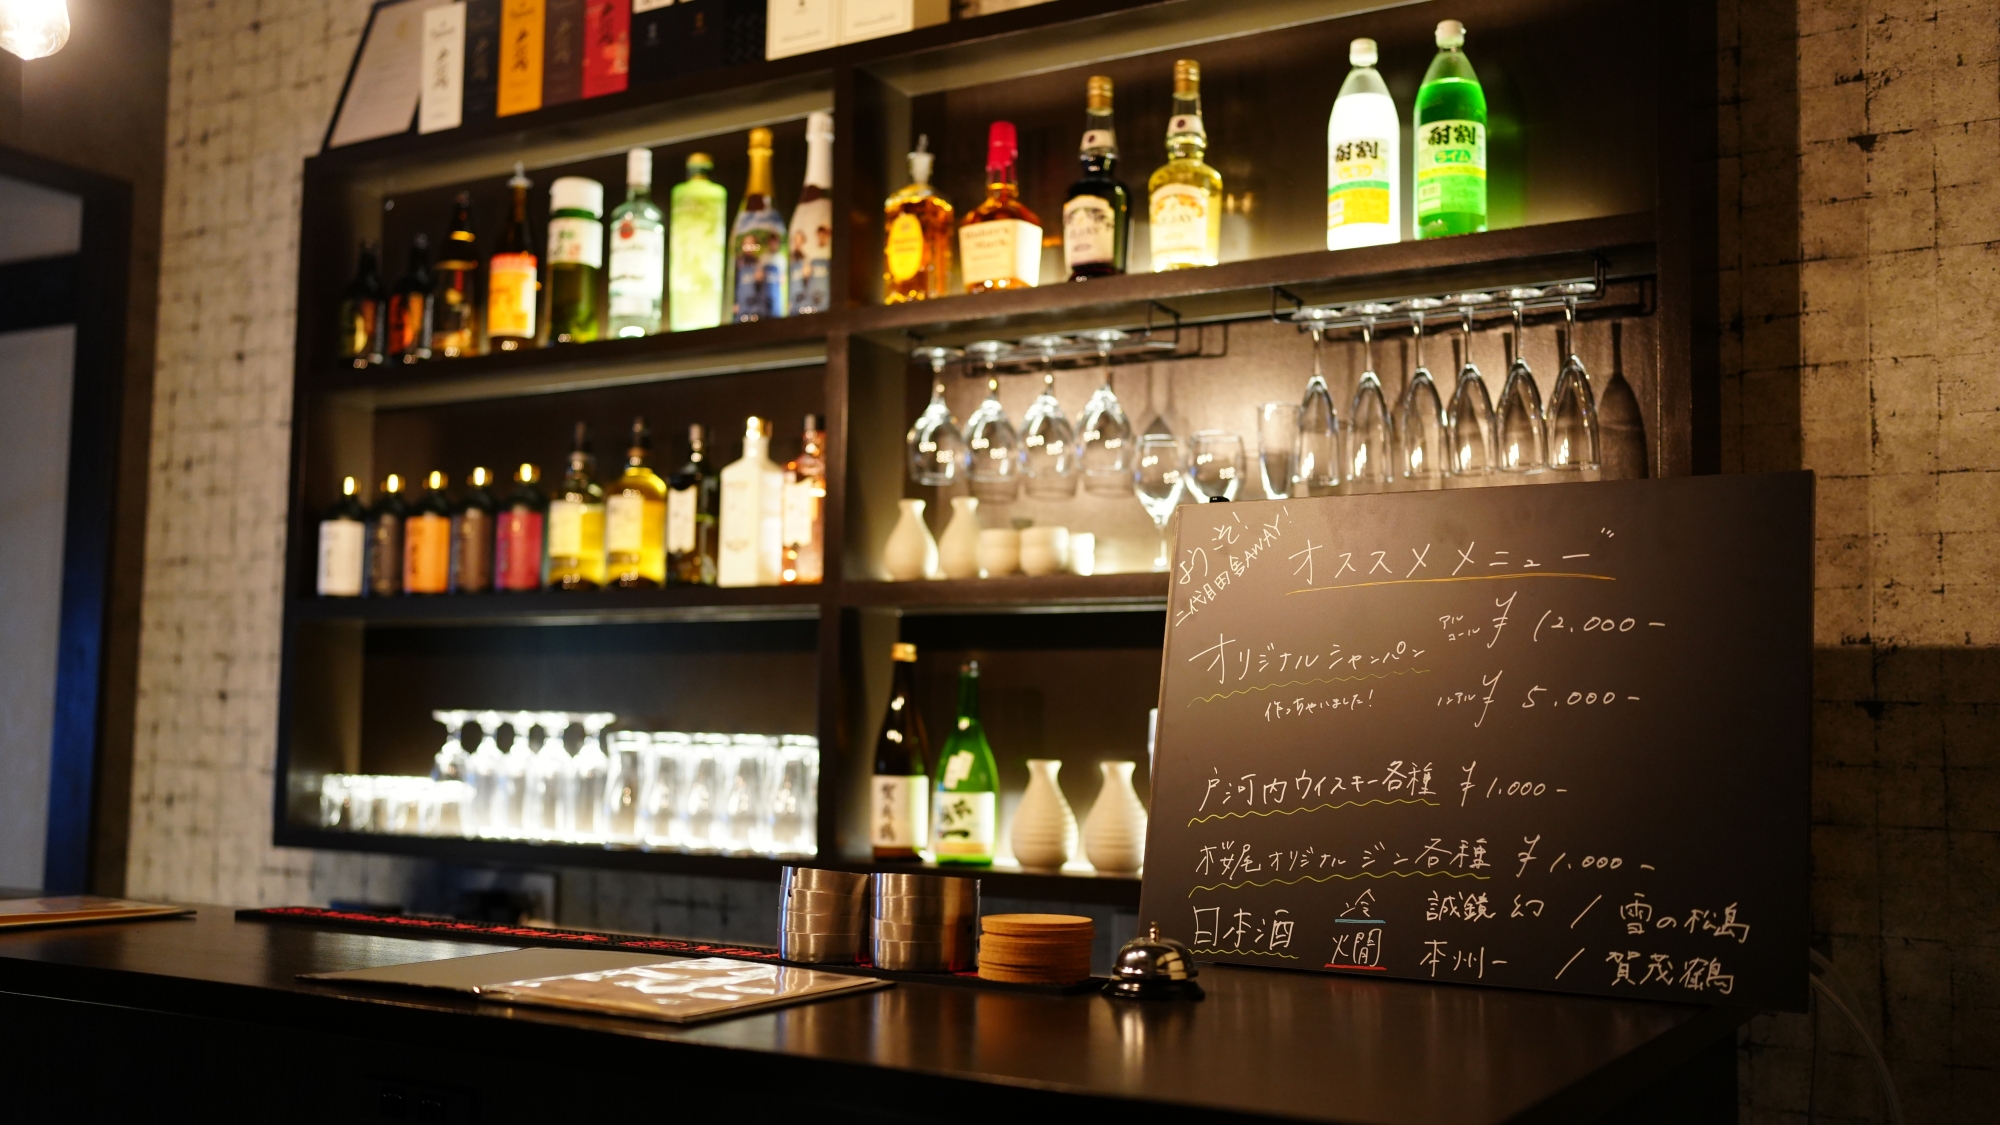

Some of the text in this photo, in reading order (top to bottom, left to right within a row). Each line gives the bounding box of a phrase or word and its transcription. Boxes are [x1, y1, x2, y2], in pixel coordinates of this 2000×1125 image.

[1339, 888, 1376, 918] 冷
[1193, 905, 1295, 950] 日本酒
